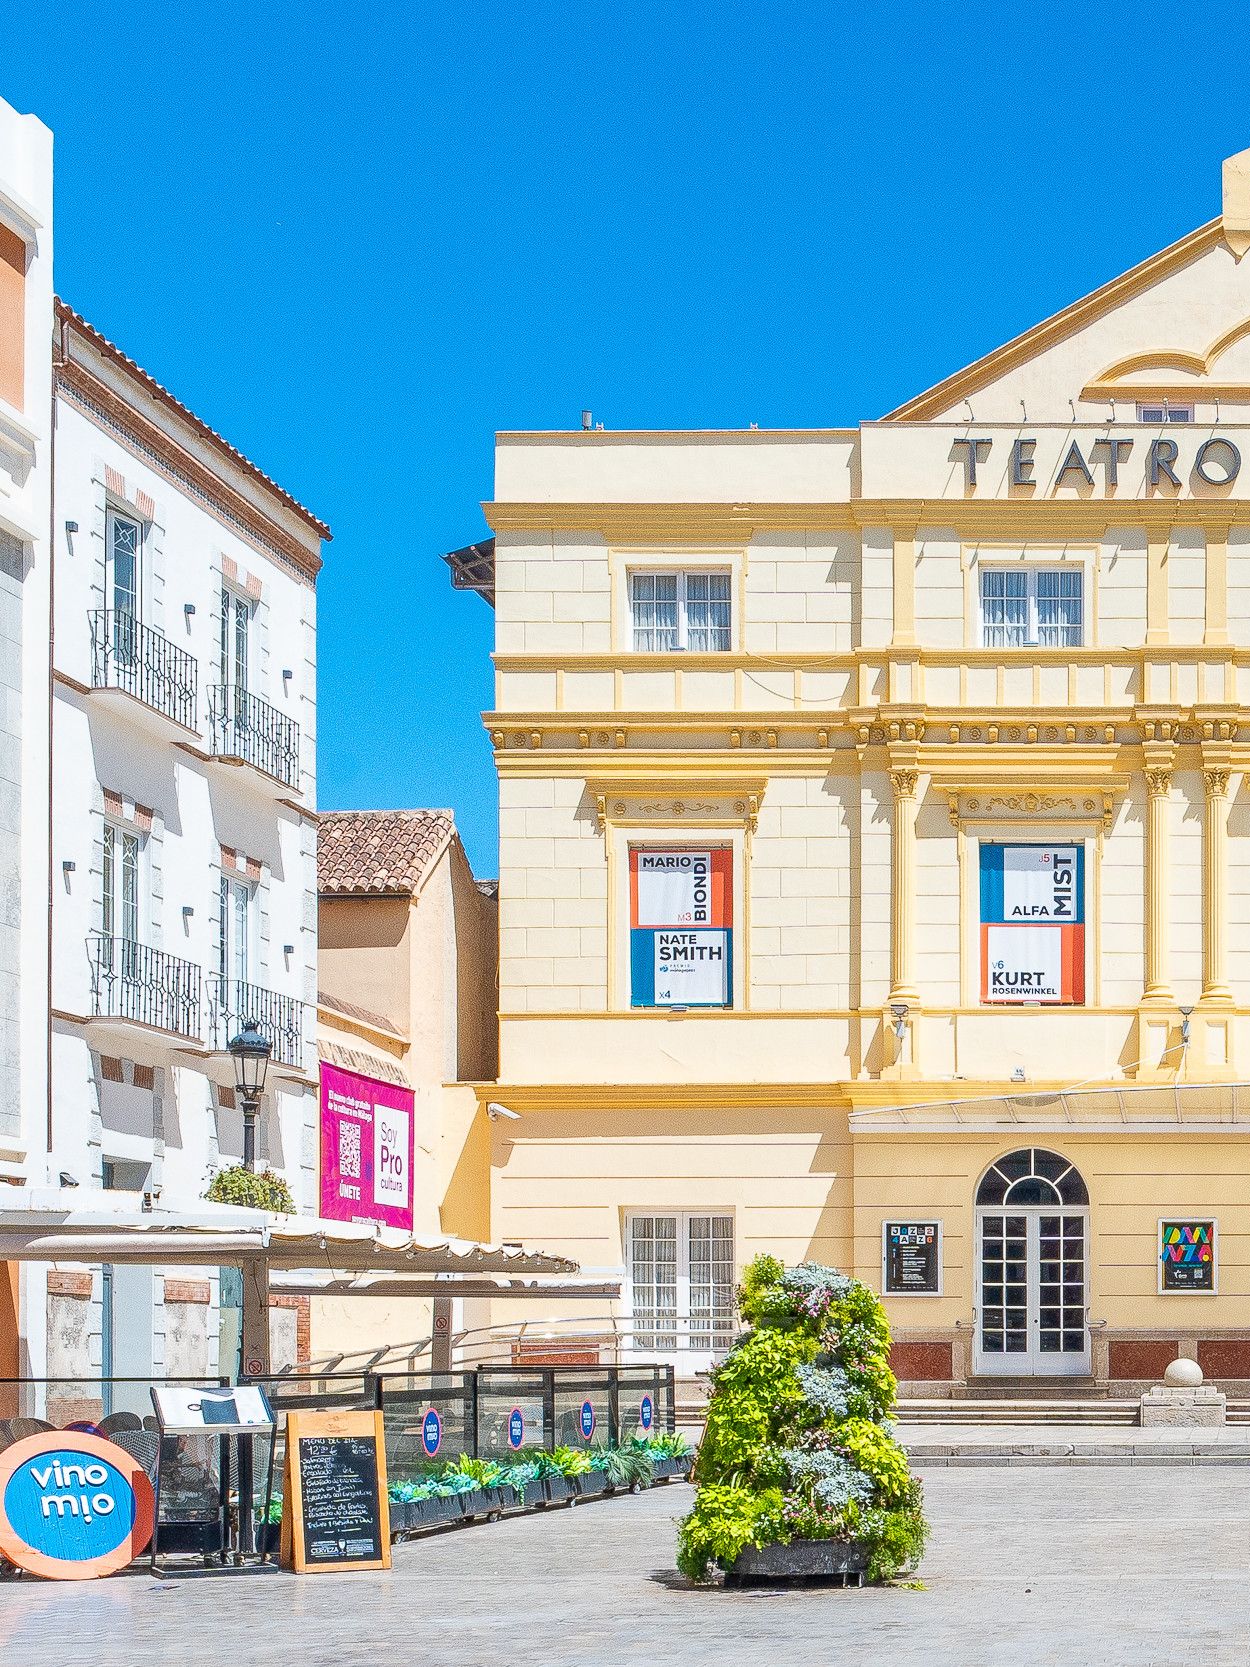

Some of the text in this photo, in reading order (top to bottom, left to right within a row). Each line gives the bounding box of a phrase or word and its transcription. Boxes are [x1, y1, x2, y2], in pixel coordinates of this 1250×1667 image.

[953, 437, 1242, 486] TEATRO
[643, 857, 691, 867] MARIO
[694, 857, 707, 921] BIONDI
[1053, 853, 1072, 916] MIST
[677, 912, 692, 922] M3
[1012, 905, 1049, 916] ALFA
[660, 934, 697, 945] NATE
[659, 946, 722, 960] SMITH
[992, 971, 1045, 986] KURT
[992, 987, 1057, 995] ROSENWINKEL
[380, 1122, 398, 1149] Soy
[380, 1146, 403, 1176] Pro
[339, 1179, 361, 1201] ÚNETE
[380, 1177, 403, 1192] cultura
[30, 1459, 109, 1490] vino
